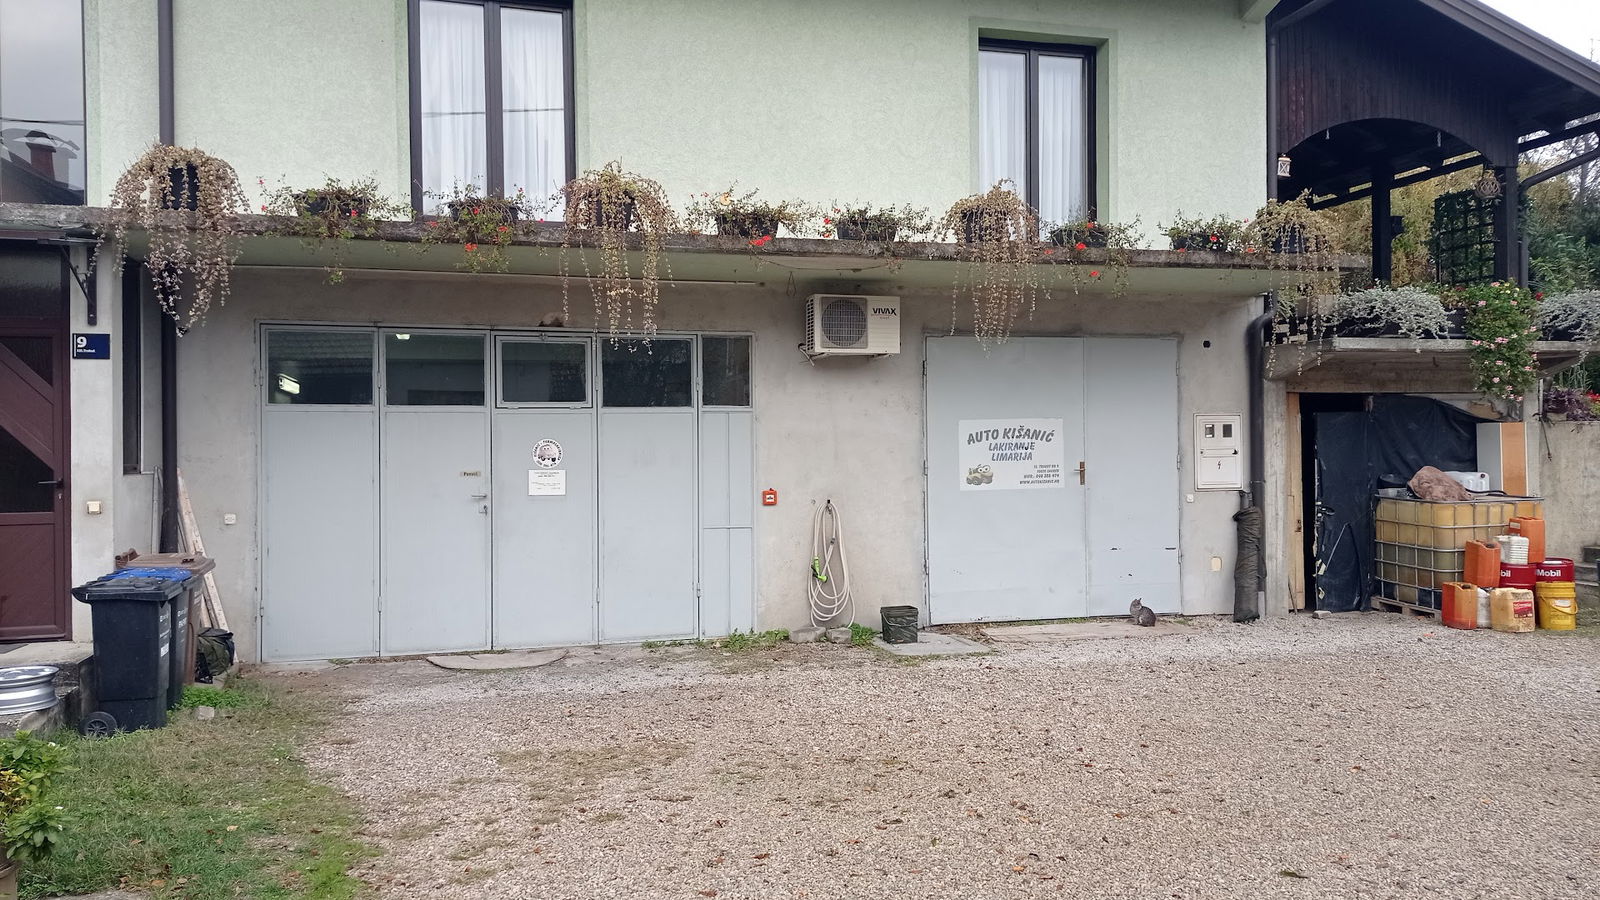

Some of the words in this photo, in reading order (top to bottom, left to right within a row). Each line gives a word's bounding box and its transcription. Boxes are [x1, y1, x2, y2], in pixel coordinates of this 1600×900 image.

[872, 307, 897, 316] VIVAX
[77, 336, 87, 348] 9
[967, 428, 999, 445] AUTO
[1002, 425, 1055, 443] KIŠANIĆ
[988, 441, 1035, 452] LAKIRANJE
[991, 452, 1033, 462] LIMARIJA
[1537, 569, 1561, 577] Mobil
